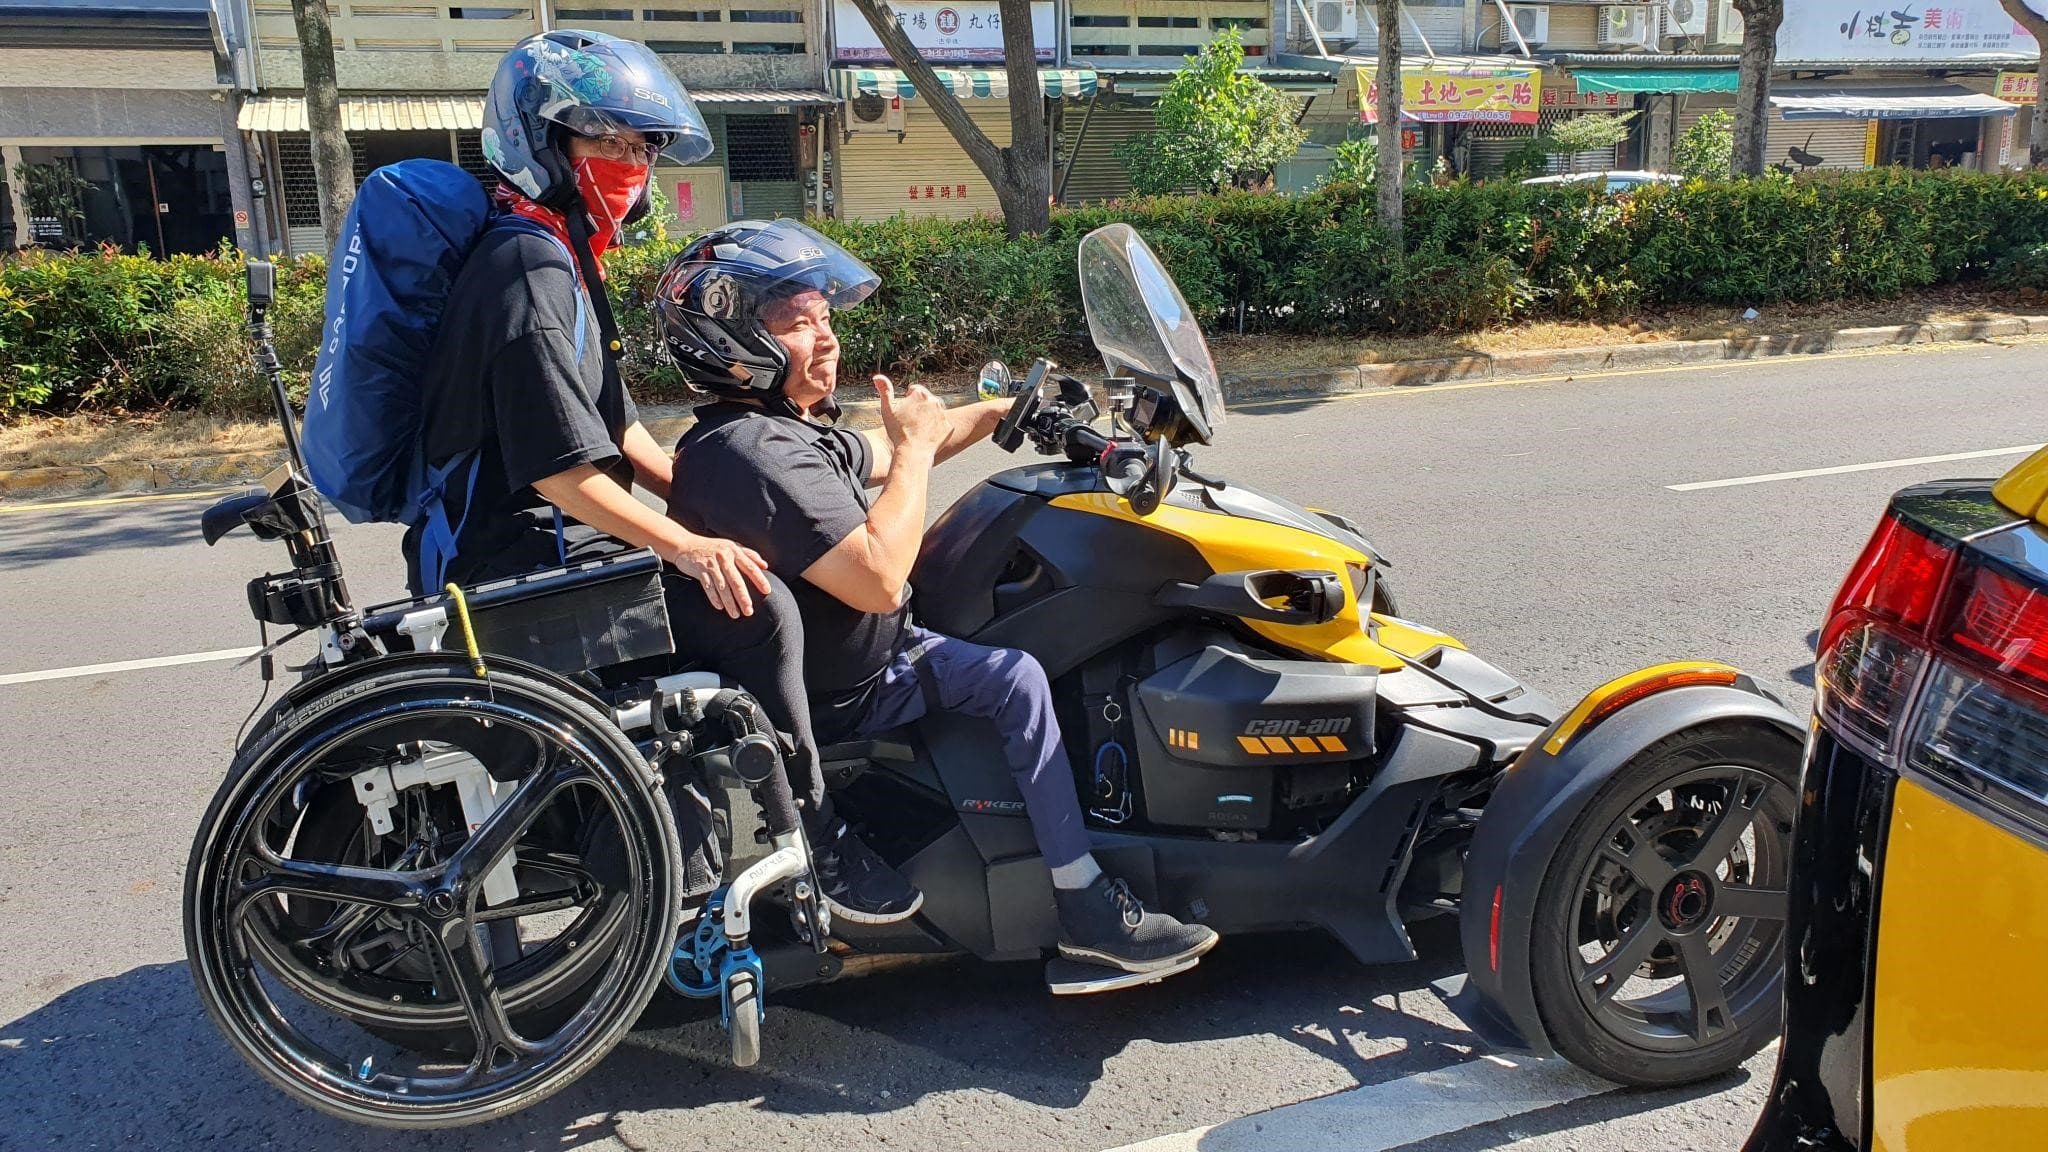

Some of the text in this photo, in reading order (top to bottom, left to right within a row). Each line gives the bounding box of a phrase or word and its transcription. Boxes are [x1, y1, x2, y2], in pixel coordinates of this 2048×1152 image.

[908, 183, 967, 200] 營業時間
[1244, 717, 1352, 736] can-am
[962, 799, 1025, 812] RYKER
